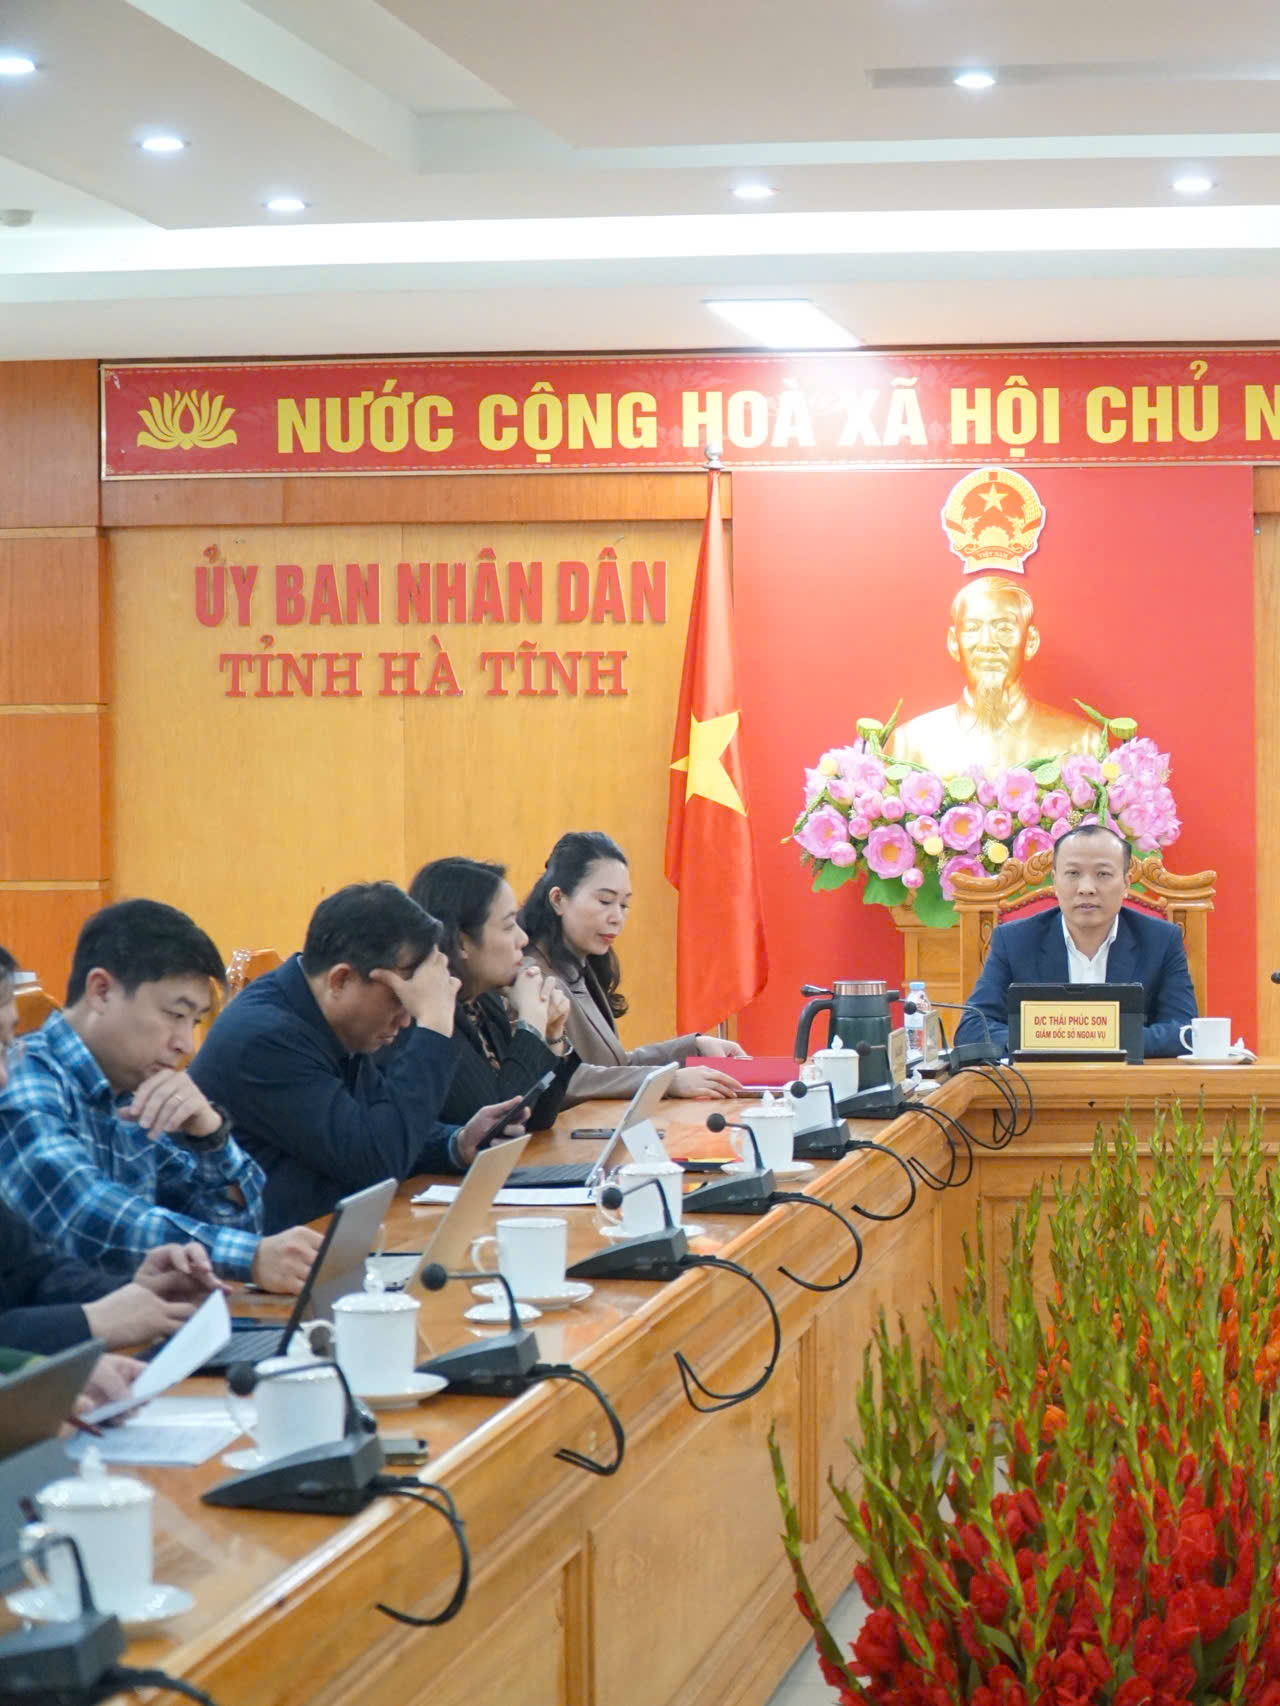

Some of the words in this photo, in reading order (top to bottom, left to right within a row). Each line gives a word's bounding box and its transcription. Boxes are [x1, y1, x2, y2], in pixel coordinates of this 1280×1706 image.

[277, 378, 454, 454] NƯỚC
[479, 381, 658, 463] CỘNG
[682, 377, 816, 449] HOÀ
[837, 376, 928, 447] XÃ
[951, 375, 1060, 458] HỘI
[1086, 360, 1219, 443] CHỦ
[195, 544, 259, 627] ỦY
[275, 563, 382, 625] BAN
[397, 547, 544, 624] NHÂN
[557, 546, 667, 623] DÂN
[219, 634, 364, 697] TỈNH
[378, 634, 464, 697] HÀ
[480, 640, 628, 696] TĨNH
